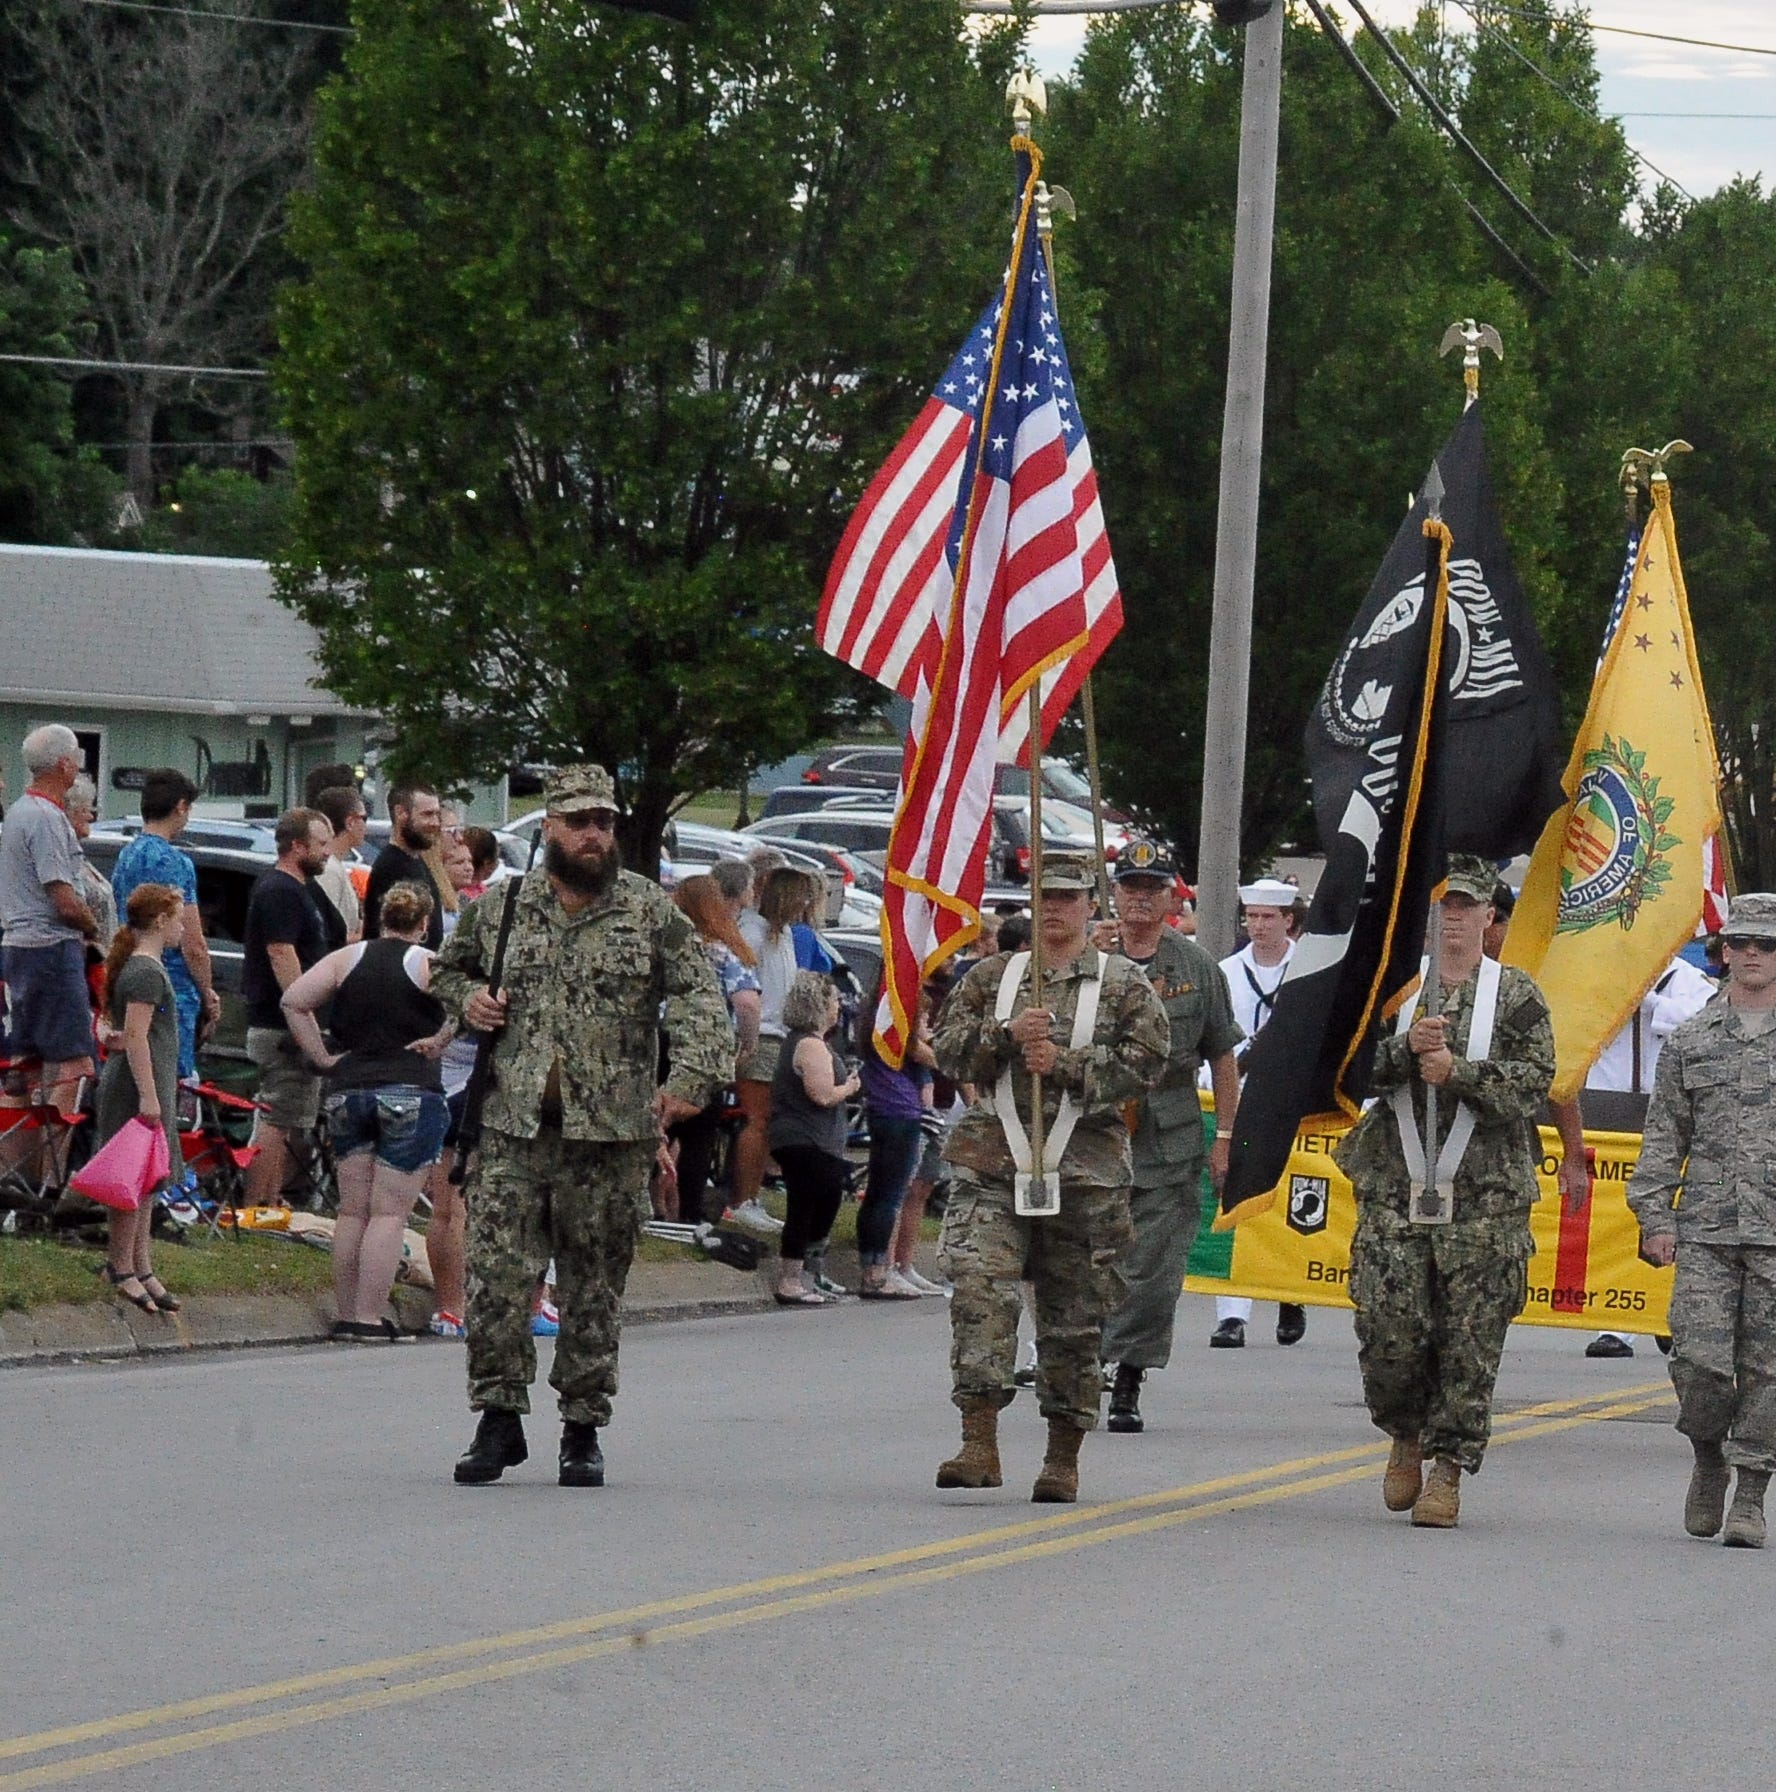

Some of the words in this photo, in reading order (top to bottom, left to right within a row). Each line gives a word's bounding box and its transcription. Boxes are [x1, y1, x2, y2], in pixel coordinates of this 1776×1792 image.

[1453, 638, 1524, 699] MIA
[1527, 1286, 1599, 1310] apter
[1604, 1288, 1647, 1312] 255
